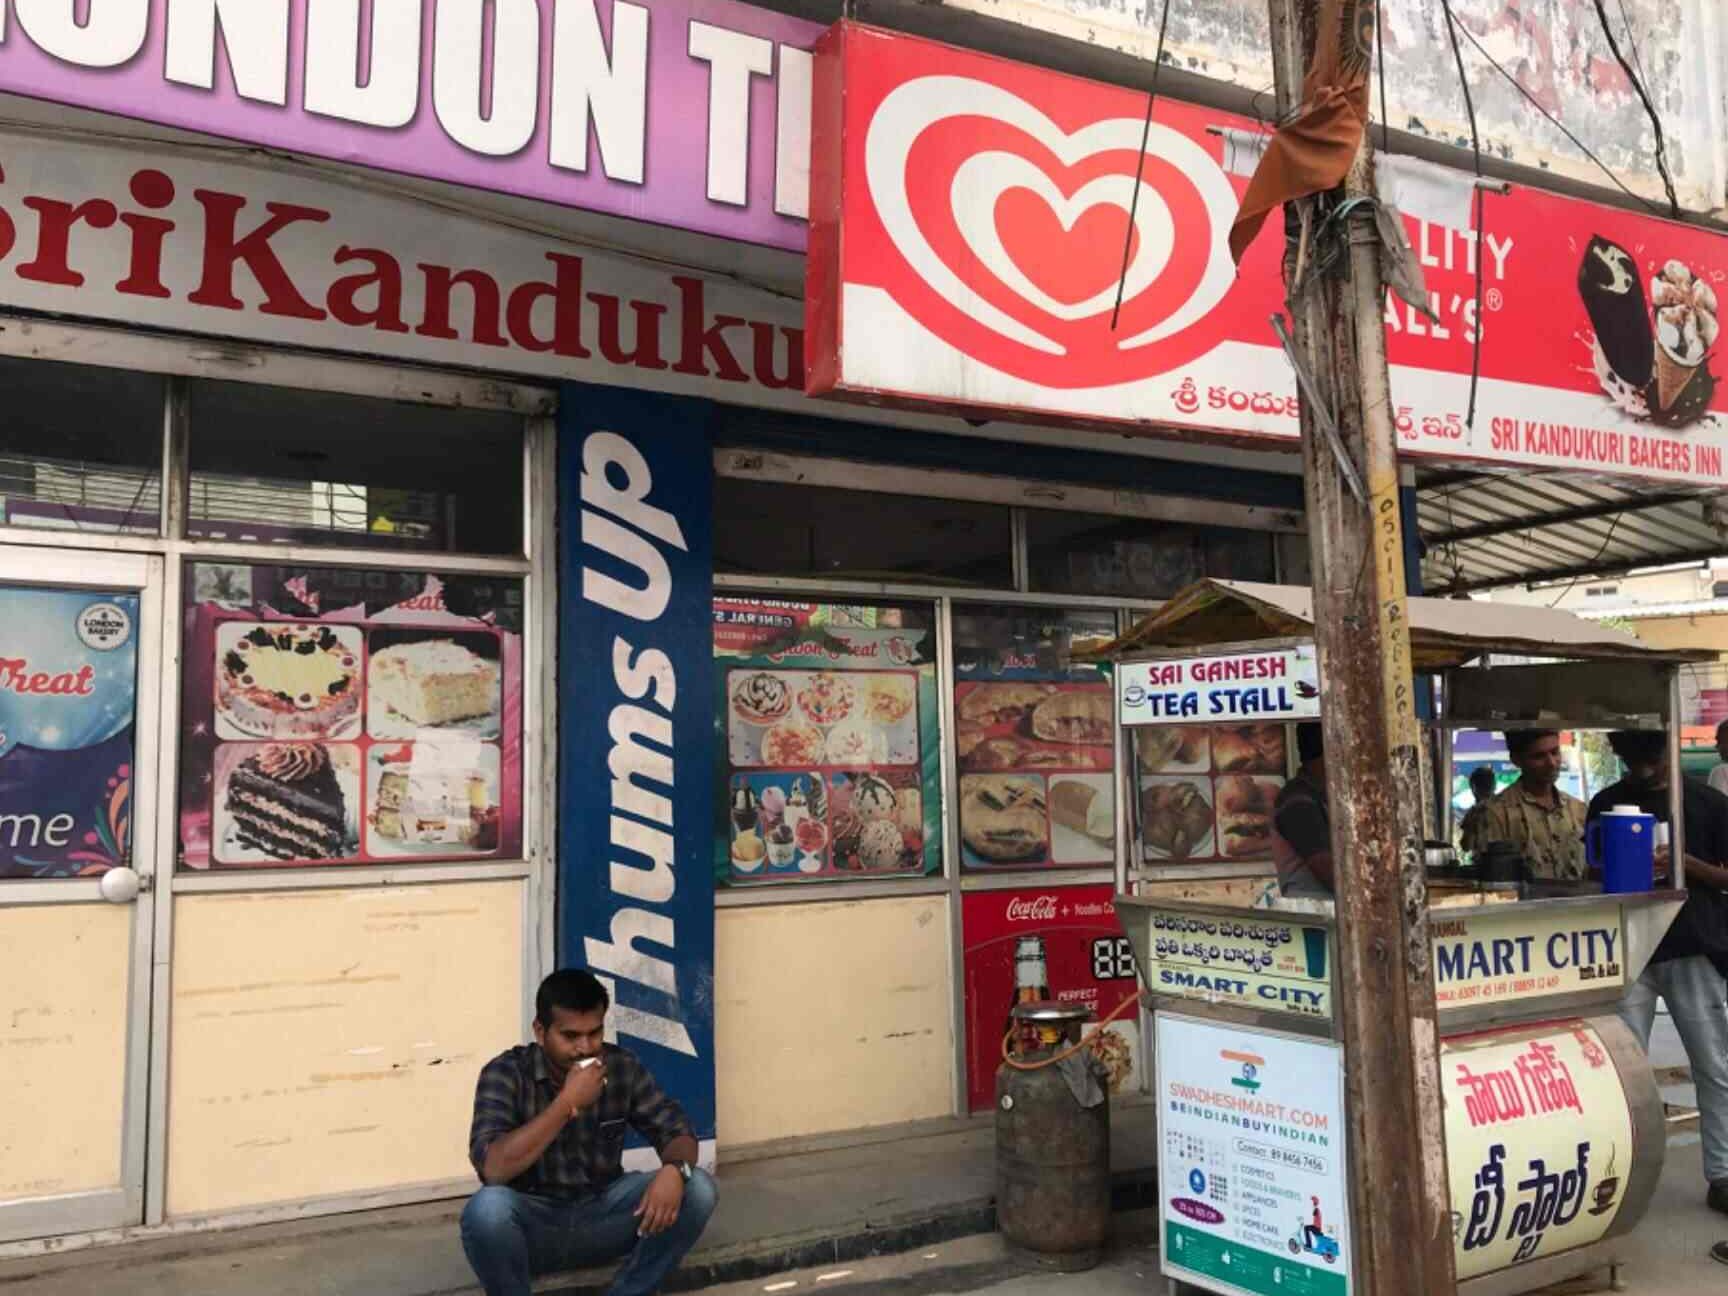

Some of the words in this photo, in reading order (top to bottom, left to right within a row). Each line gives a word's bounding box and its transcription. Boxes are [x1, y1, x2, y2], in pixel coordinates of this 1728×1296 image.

[1405, 218, 1514, 280] LITY
[1382, 284, 1485, 345] ALL'S
[1171, 377, 1200, 414] శ్రీ
[1491, 416, 1520, 452] SRI
[1524, 422, 1624, 464] KANDUKURI
[1629, 436, 1690, 474] BAKERS
[1695, 444, 1722, 477] INN
[579, 429, 689, 623] Up
[1149, 665, 1183, 686] SAI
[1190, 656, 1287, 682] GANESH
[1147, 691, 1199, 718] TEA
[1208, 686, 1294, 714] STALL
[1006, 895, 1059, 921] Coca-Cola
[1546, 927, 1618, 970] CITY
[1159, 969, 1249, 996] SMART
[1257, 984, 1325, 1006] CITY
[1169, 1082, 1329, 1131] SWADHESHMART.COM
